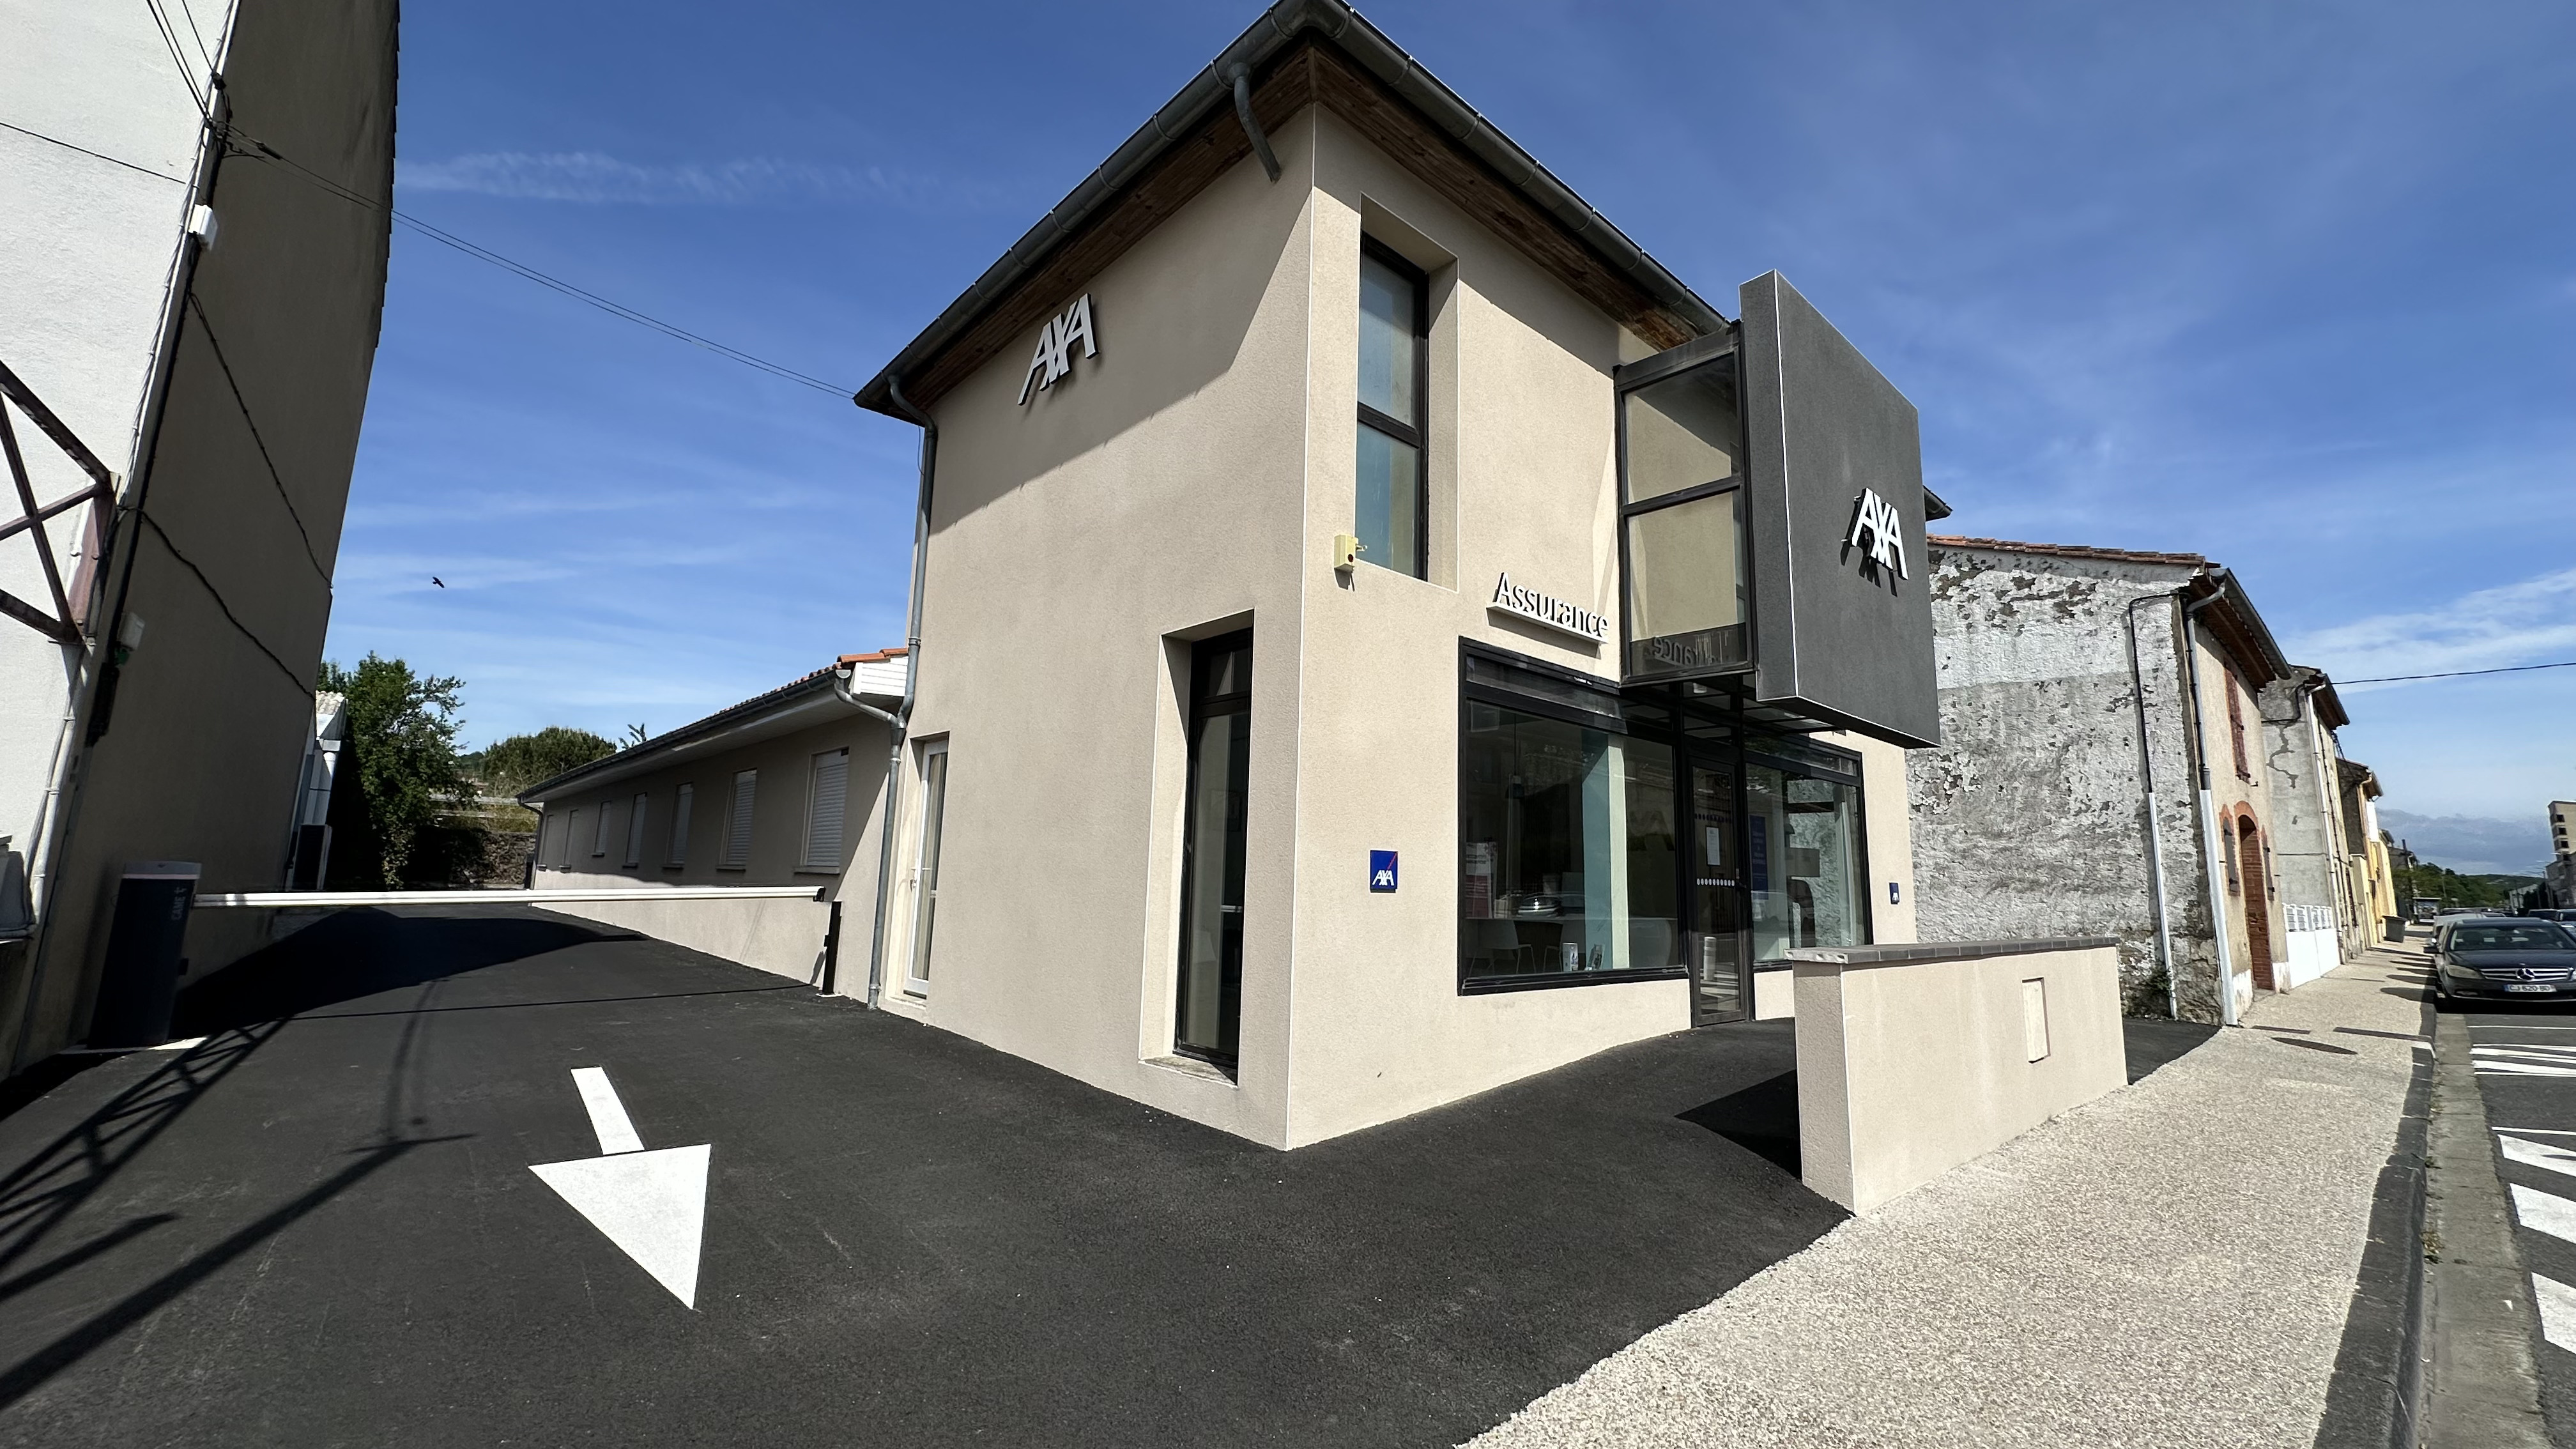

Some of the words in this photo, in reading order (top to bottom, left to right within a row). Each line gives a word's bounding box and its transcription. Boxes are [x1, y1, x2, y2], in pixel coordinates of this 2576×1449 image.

[1018, 292, 1099, 406] AXA
[1851, 487, 1909, 580] AXA
[1492, 572, 1609, 638] Assurance
[1372, 870, 1395, 886] AXA
